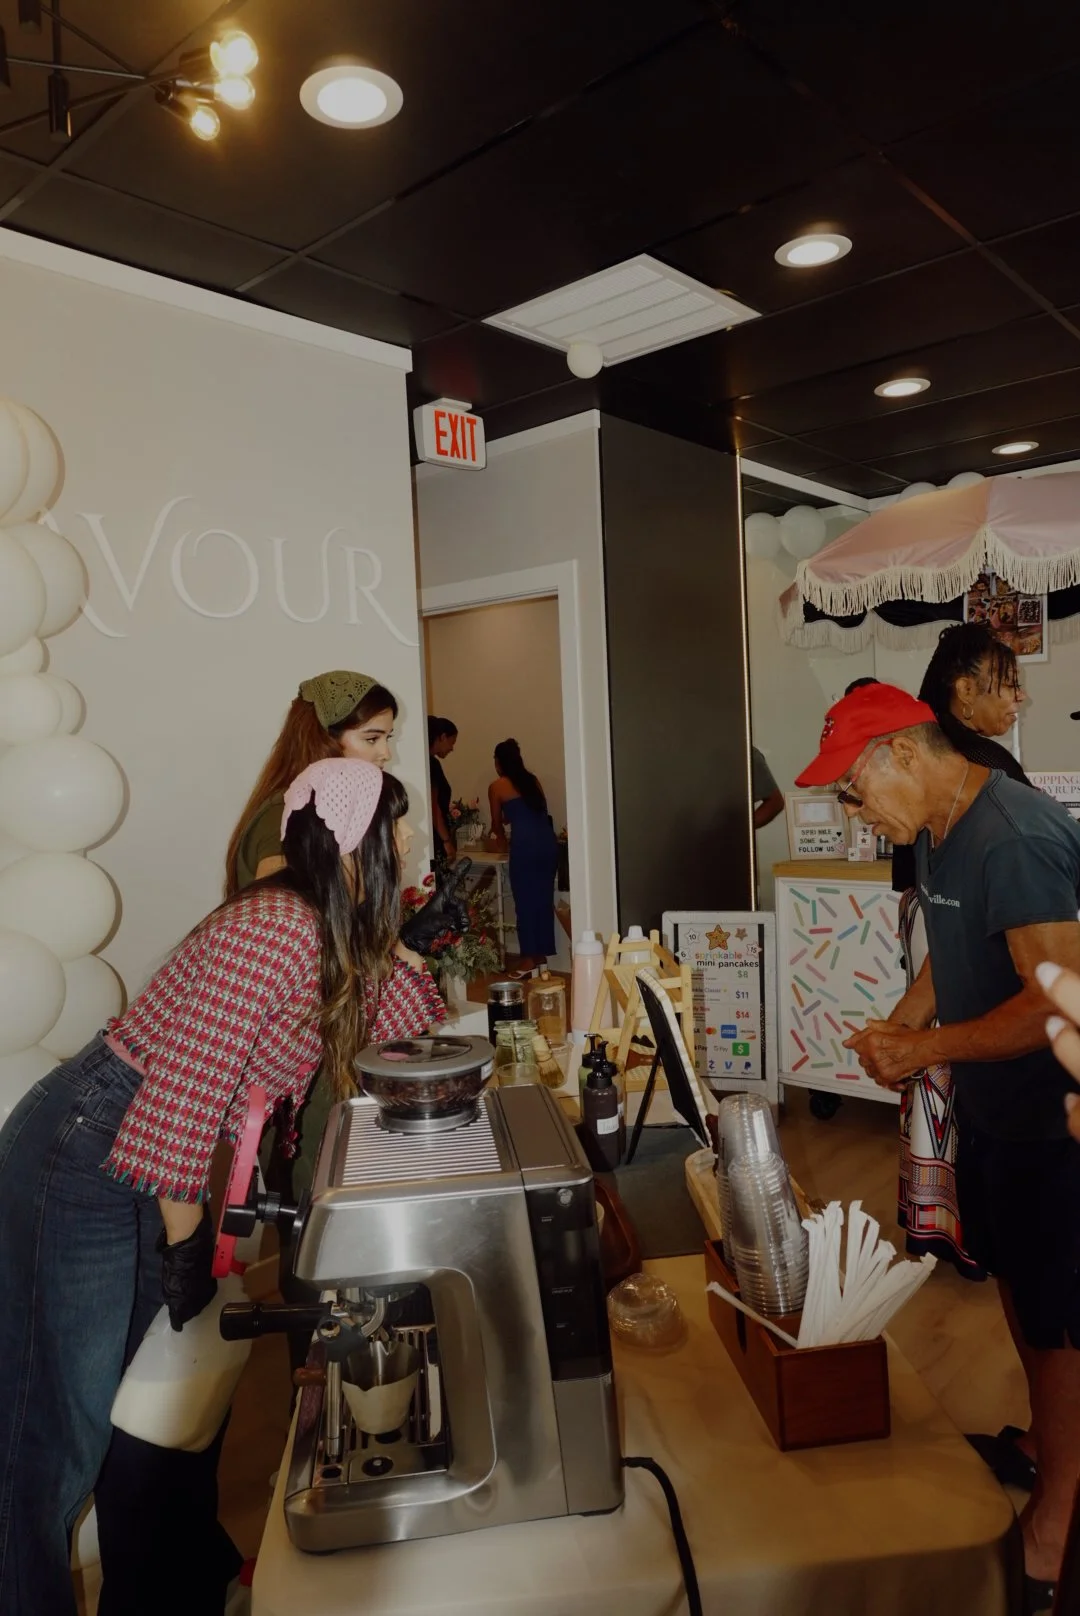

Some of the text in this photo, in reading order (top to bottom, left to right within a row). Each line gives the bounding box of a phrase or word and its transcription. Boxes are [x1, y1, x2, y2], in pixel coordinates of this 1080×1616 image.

[434, 410, 478, 463] EXIT
[38, 496, 420, 648] VOUR
[798, 845, 823, 853] FOLLOW
[688, 933, 697, 941] 10
[750, 946, 758, 954] 15
[696, 959, 716, 967] mini
[718, 960, 759, 969] pancakes
[737, 970, 749, 979] $8
[735, 990, 749, 1000] $11
[735, 1010, 750, 1020] $14
